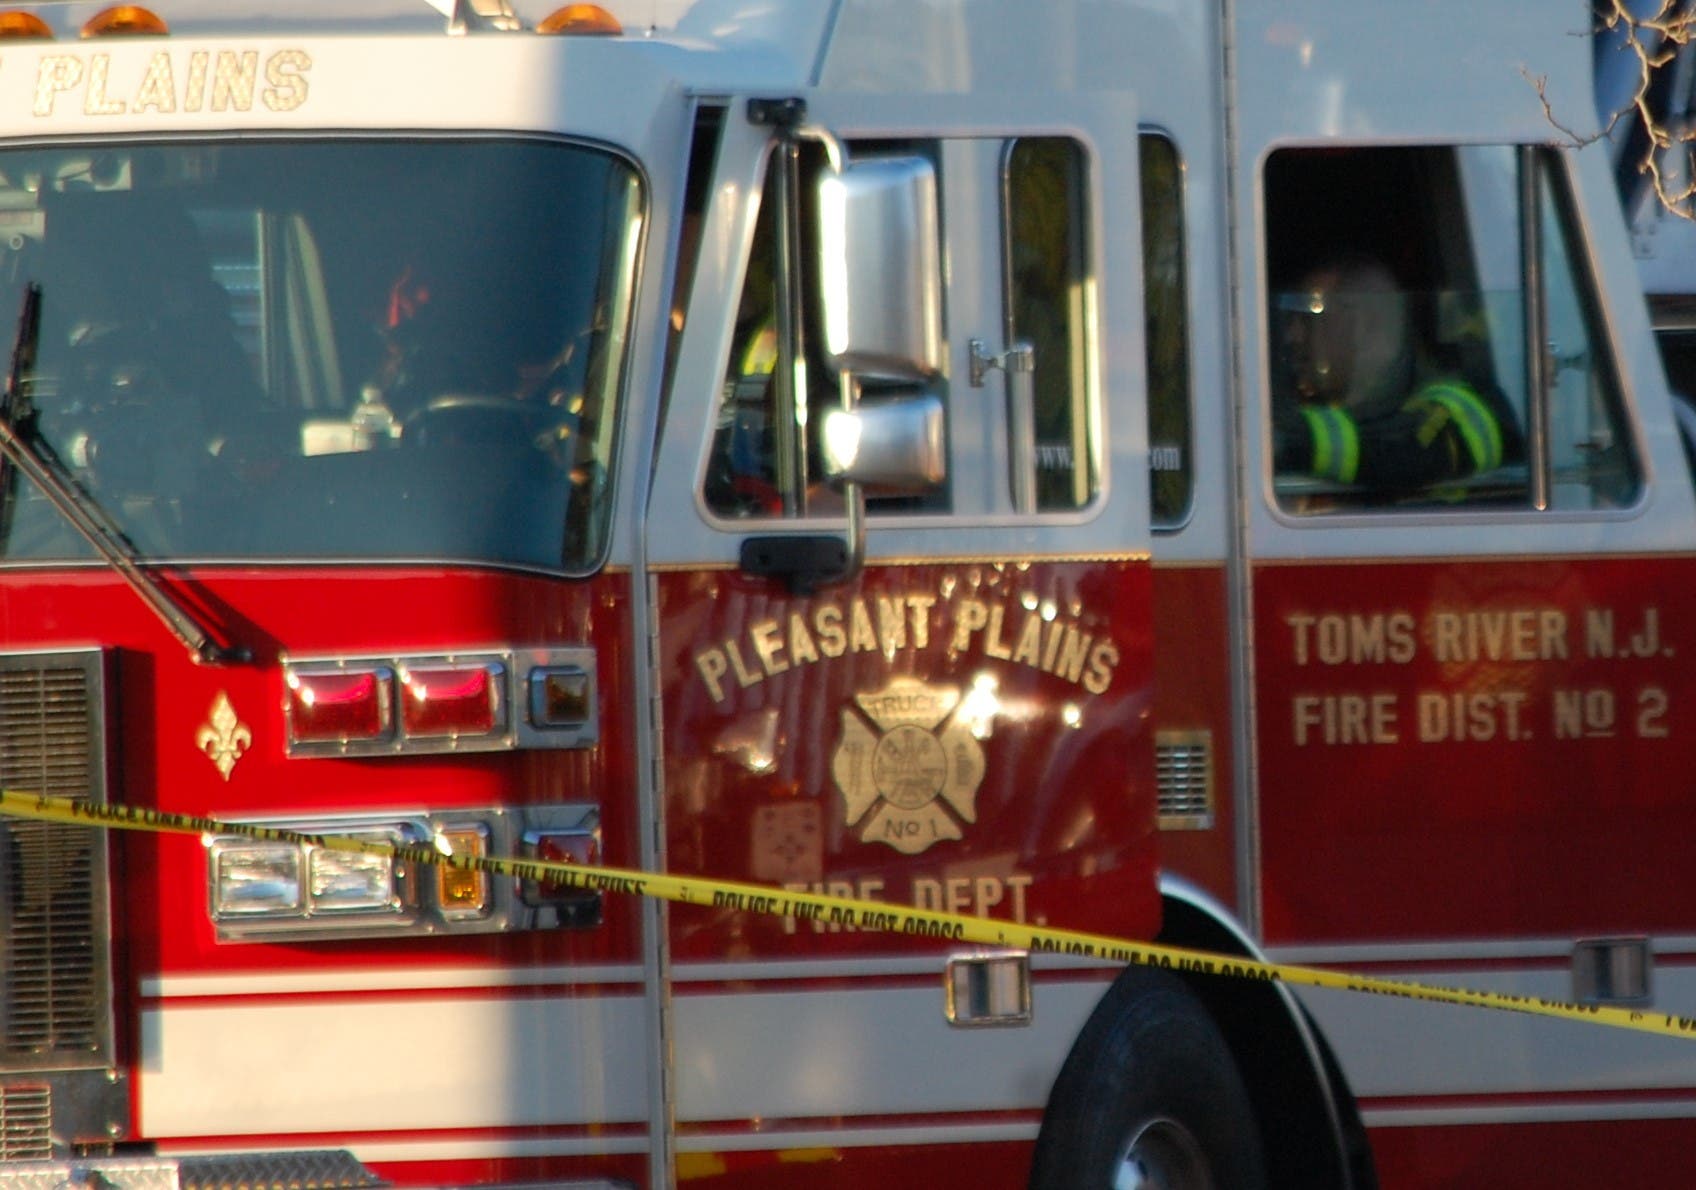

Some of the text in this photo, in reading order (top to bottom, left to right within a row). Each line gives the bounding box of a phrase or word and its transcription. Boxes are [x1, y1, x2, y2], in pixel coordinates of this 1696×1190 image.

[33, 49, 312, 117] PLAINS
[696, 595, 1120, 703] PLEASANT PLAINS
[1288, 608, 1675, 665] TOMS RIVER N.J.
[1293, 694, 1399, 747] FIRE
[1418, 691, 1534, 743] DIST.
[1637, 688, 1669, 739] 2
[929, 817, 939, 840] 1
